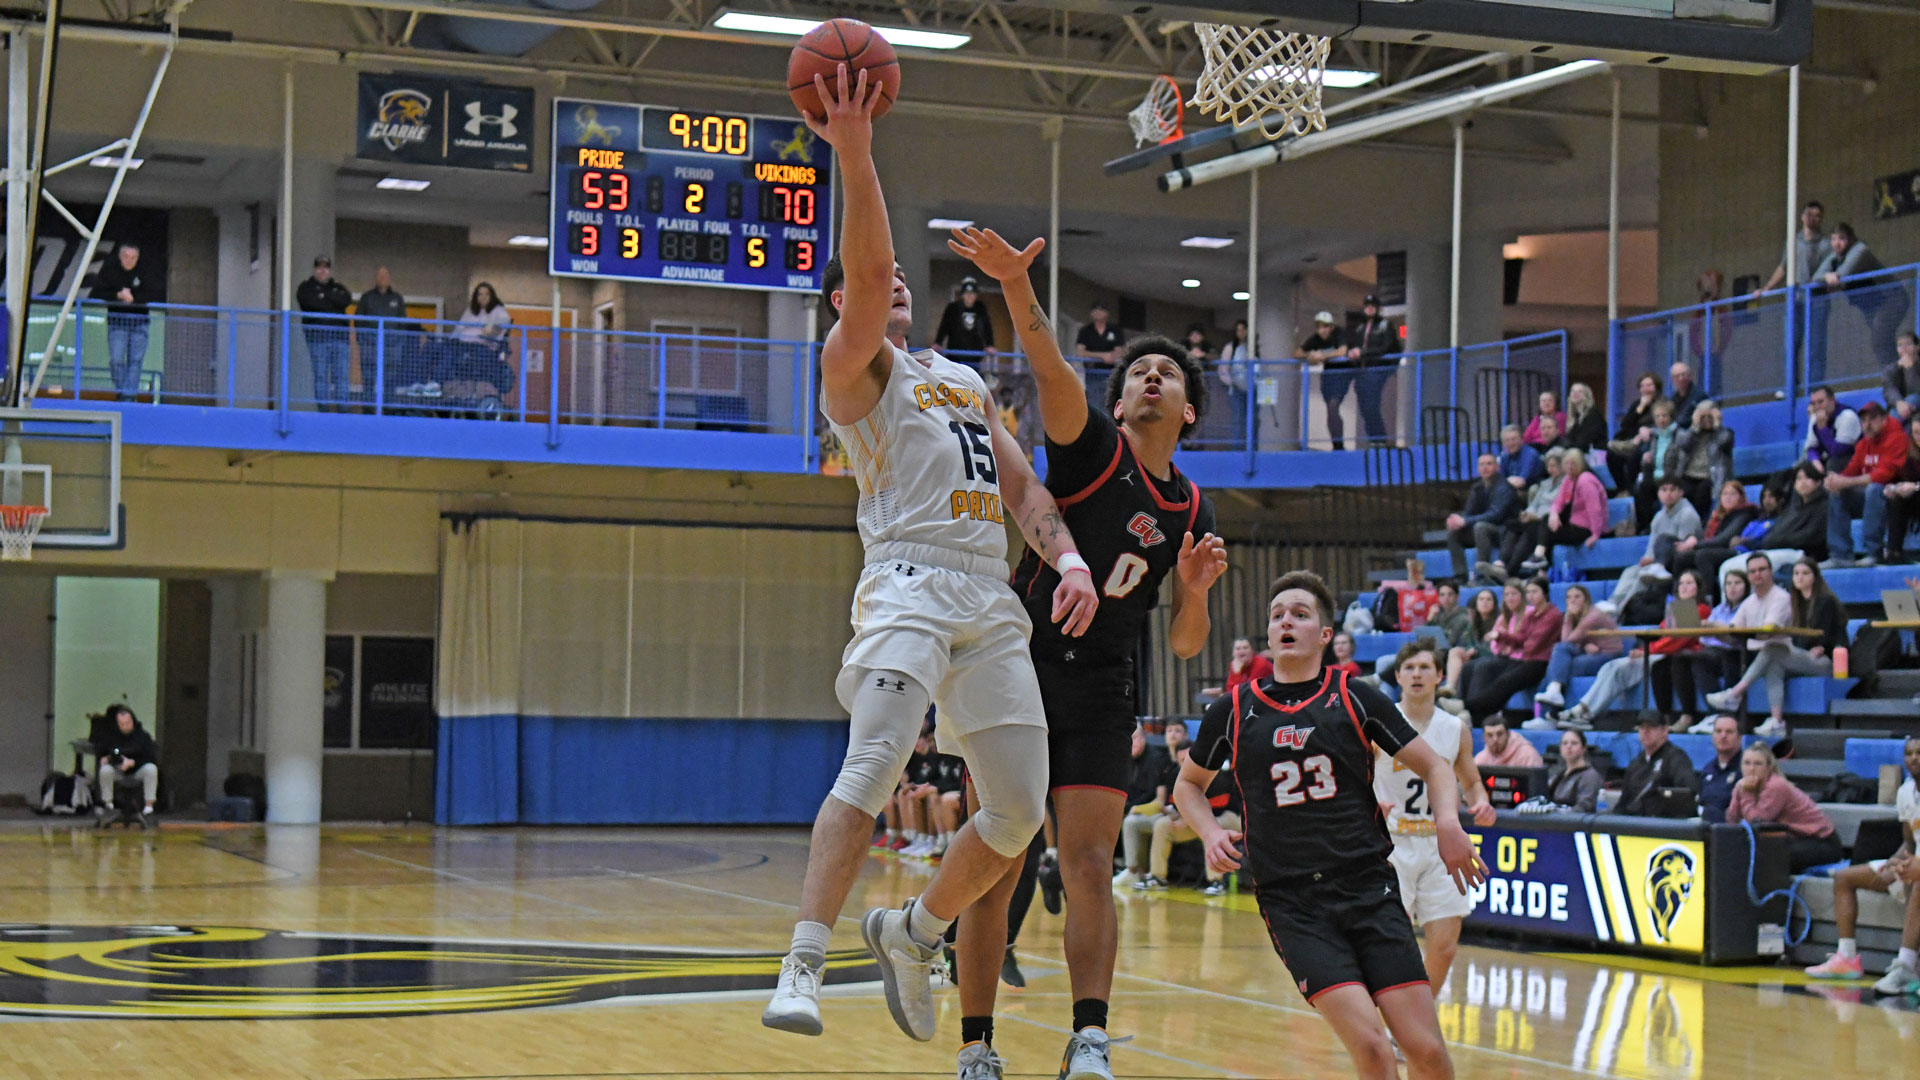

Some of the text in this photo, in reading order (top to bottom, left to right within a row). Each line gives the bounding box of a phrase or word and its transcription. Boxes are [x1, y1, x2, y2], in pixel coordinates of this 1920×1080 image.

[369, 122, 431, 141] CLARKE
[454, 139, 485, 148] UNDER
[669, 113, 747, 155] 9:00
[579, 148, 624, 170] PRIDE
[675, 167, 714, 180] PERIOD
[755, 163, 816, 185] VIKINGS
[582, 172, 628, 211] 53
[685, 184, 704, 213] 2
[773, 187, 815, 225] 70
[567, 210, 603, 225] FOULS
[615, 214, 645, 228] T.O.L.
[657, 217, 732, 234] PLAYER FOUL
[741, 224, 771, 237] T.O.L.
[581, 225, 598, 255] 3
[622, 229, 639, 258] 3
[783, 227, 818, 240] FOULS
[571, 259, 598, 273] WON
[748, 238, 765, 268] 5
[797, 242, 812, 271] 3
[662, 266, 725, 281] ADVANTAGE
[787, 275, 813, 288] WON
[948, 420, 998, 486] 15
[1127, 512, 1167, 549] GV
[1103, 552, 1149, 599] 0
[1273, 724, 1316, 750] GV
[1269, 753, 1338, 809] 23
[1405, 778, 1432, 815] 2
[1497, 836, 1538, 874] OF
[1468, 877, 1569, 922] PRIDE
